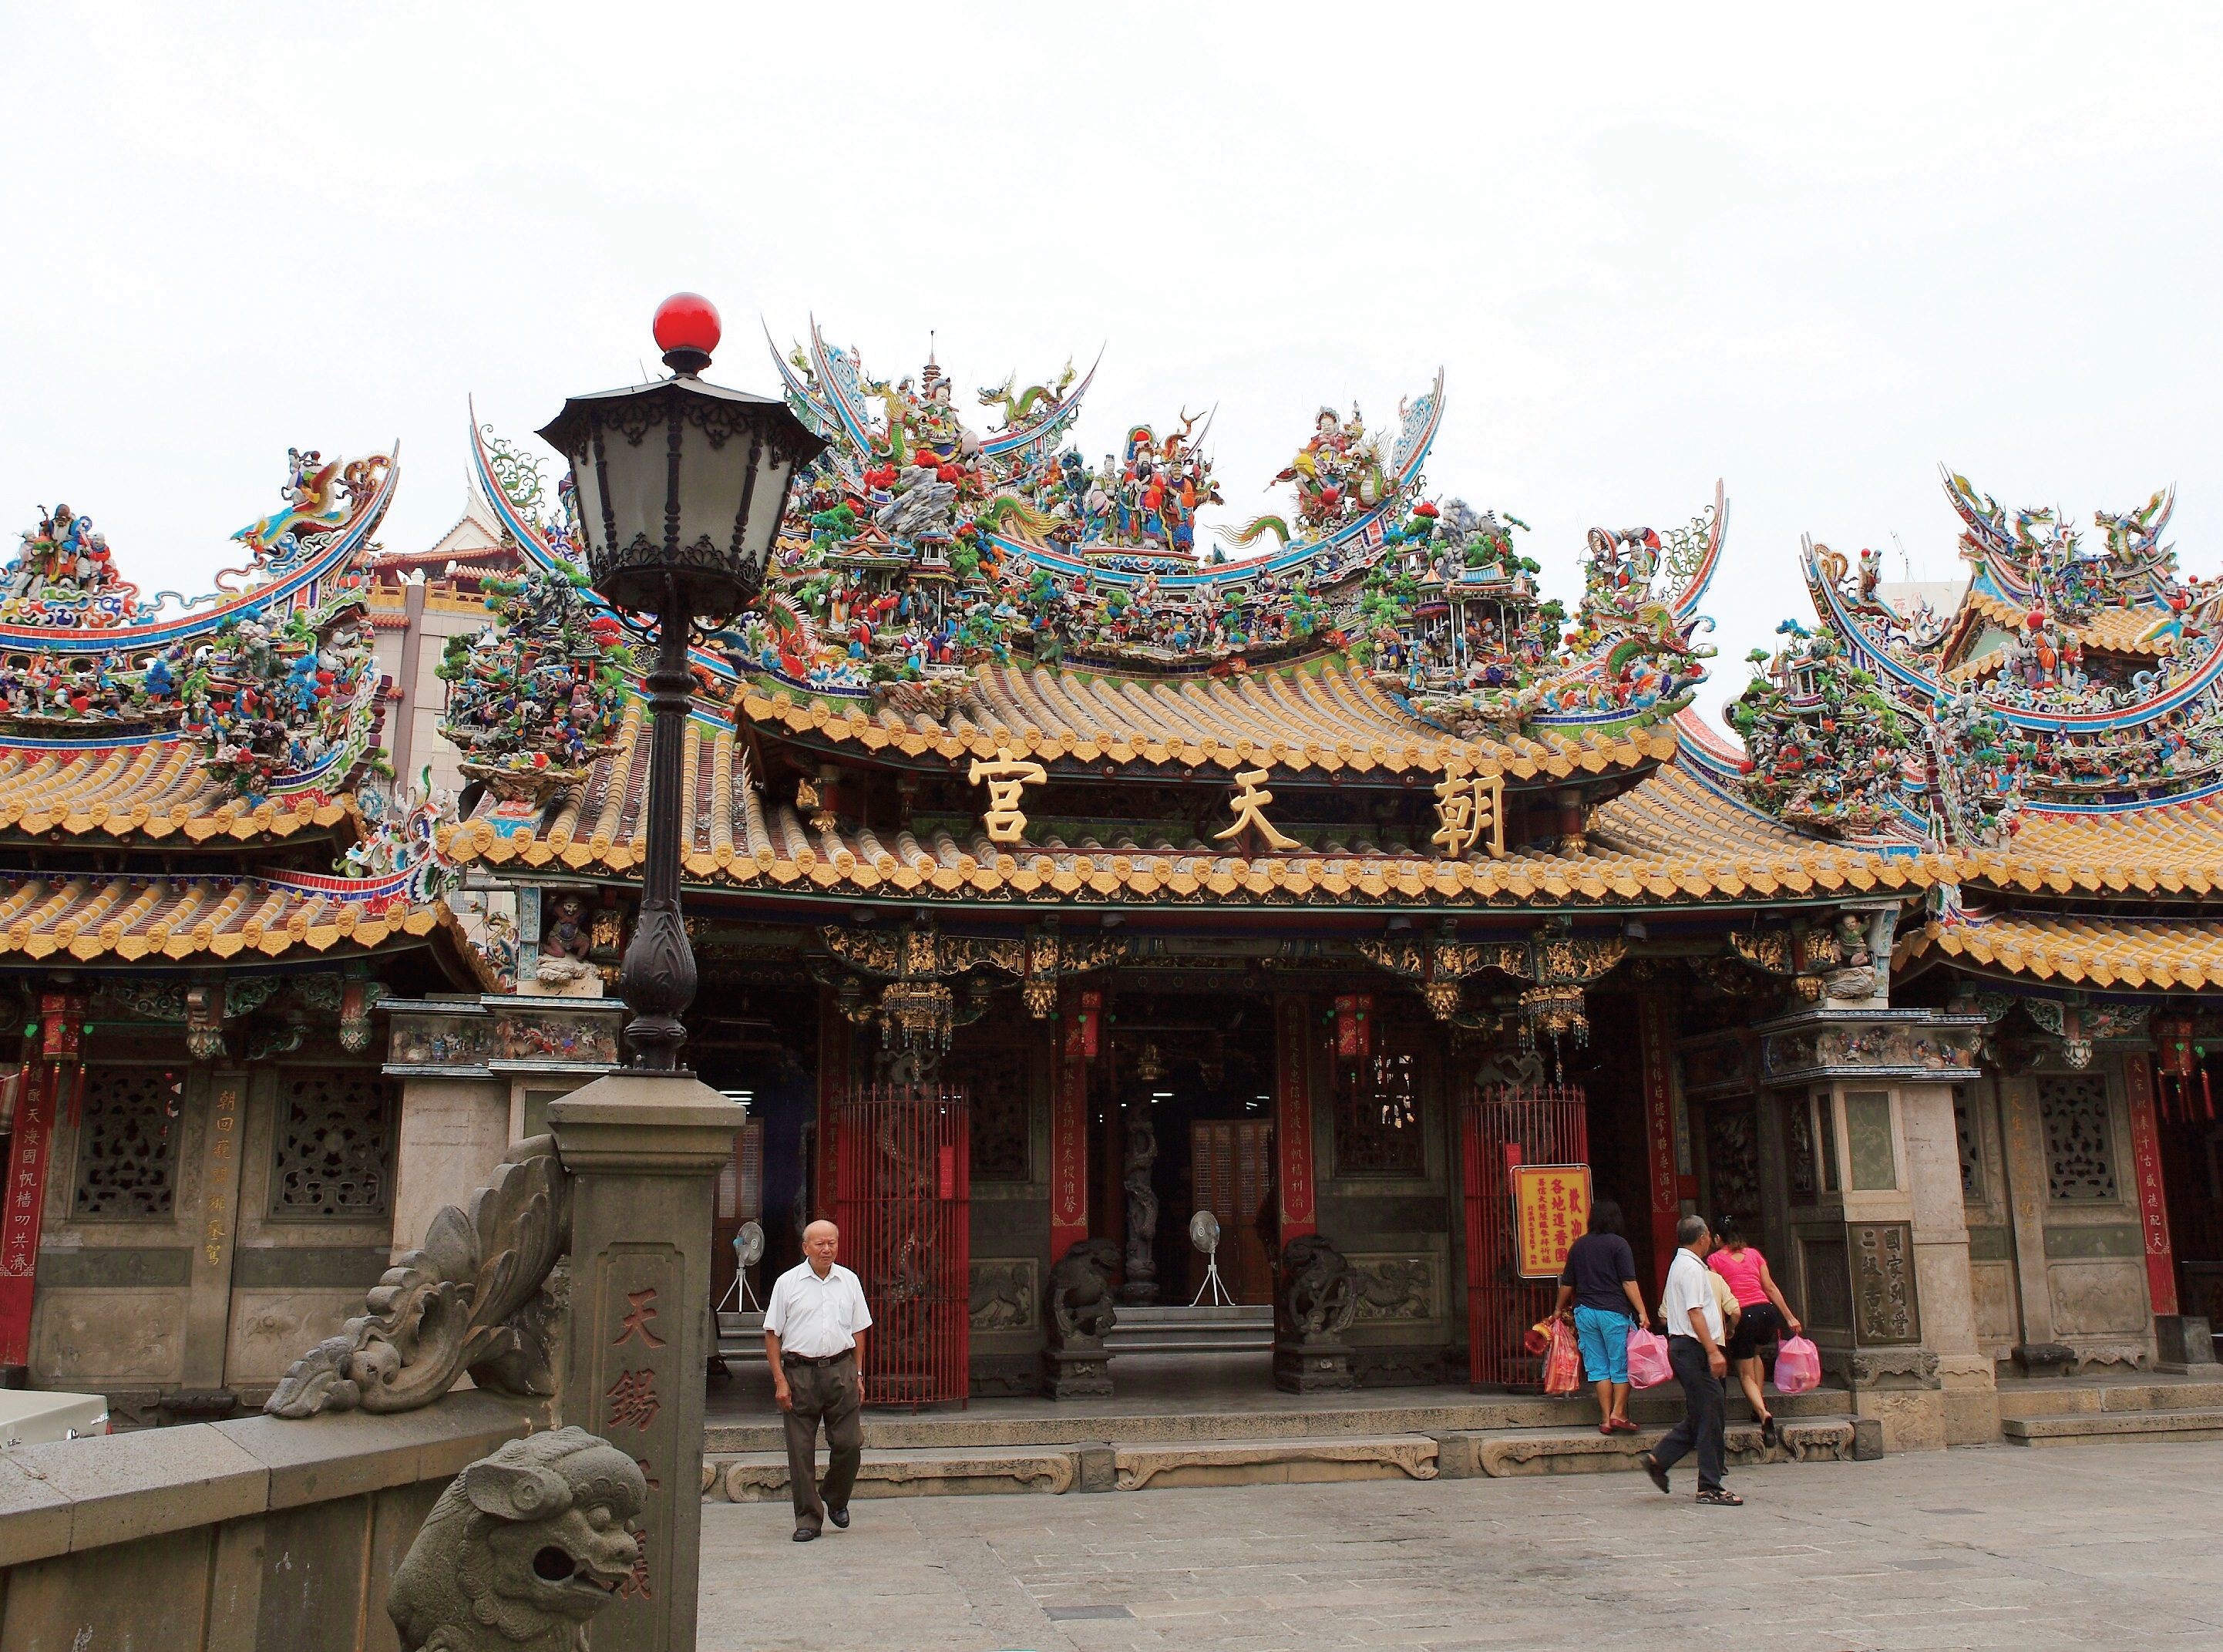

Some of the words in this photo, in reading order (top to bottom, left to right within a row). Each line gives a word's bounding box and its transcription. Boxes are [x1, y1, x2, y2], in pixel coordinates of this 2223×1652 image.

[1551, 1178, 1568, 1262] 各地進香團
